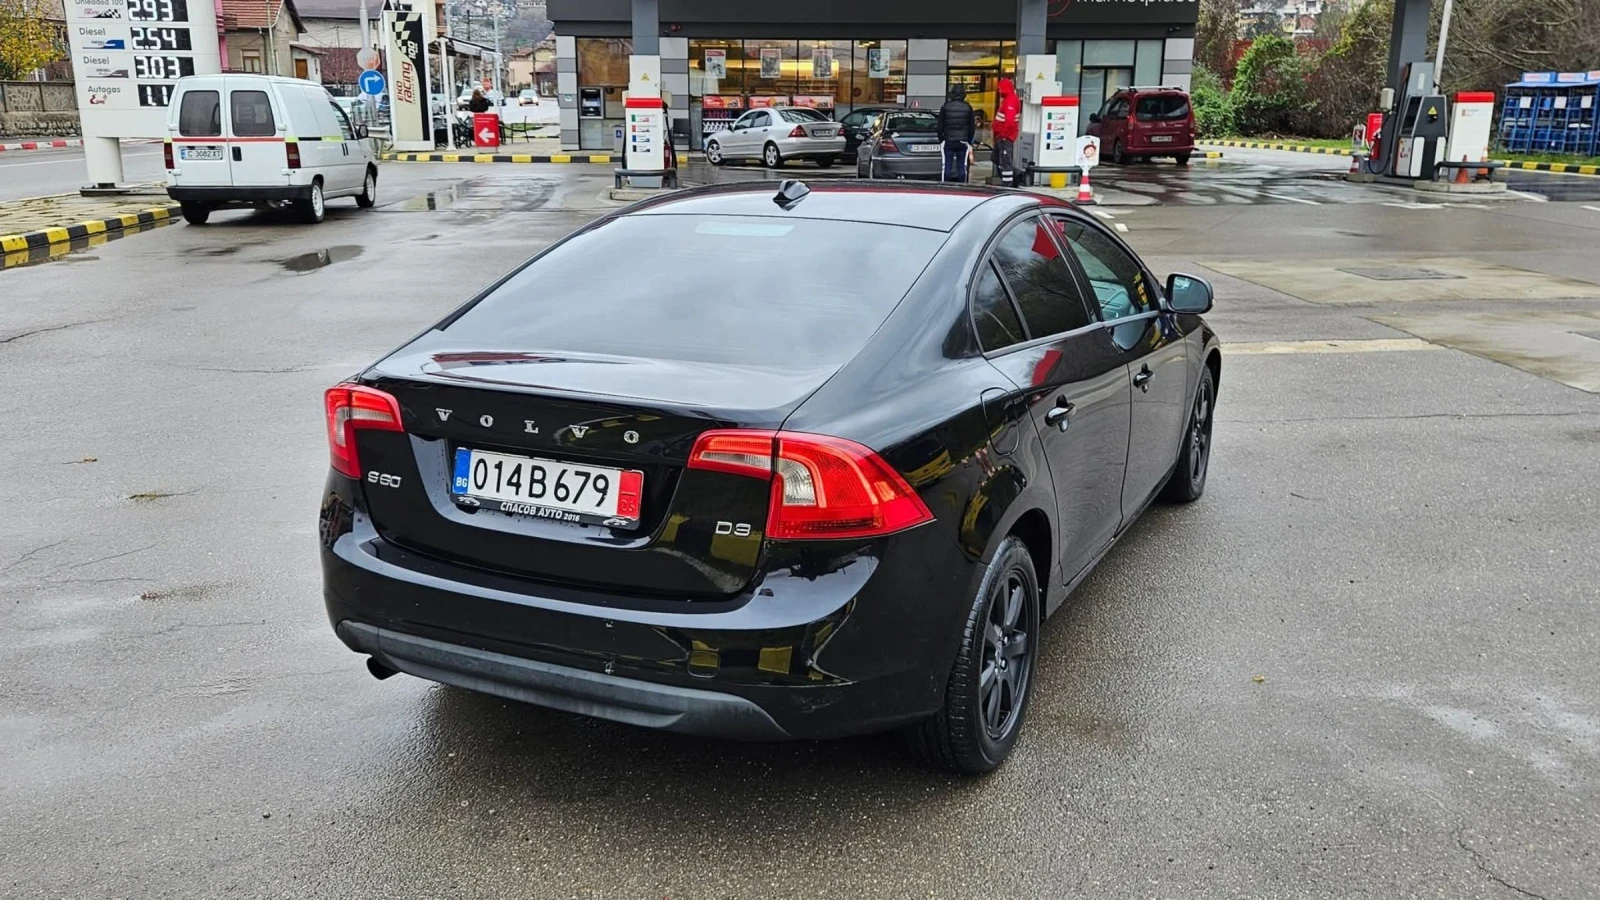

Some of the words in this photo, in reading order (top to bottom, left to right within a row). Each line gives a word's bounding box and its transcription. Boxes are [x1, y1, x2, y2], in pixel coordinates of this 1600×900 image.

[128, 0, 174, 21] 2.93
[79, 27, 106, 36] Diesel
[132, 28, 178, 50] 2.54
[83, 56, 110, 65] Diesel
[135, 56, 181, 78] 3.03
[87, 86, 121, 95] Autogas
[396, 80, 404, 101] EKO
[402, 61, 413, 103] racing
[436, 408, 640, 444] VOLVO
[367, 470, 402, 488] S60
[456, 476, 468, 488] BG
[473, 458, 610, 507] 014B679
[500, 502, 537, 515] СПАСОВ
[537, 507, 562, 519] АУТО
[563, 513, 580, 522] 2016
[715, 521, 751, 536] D3
